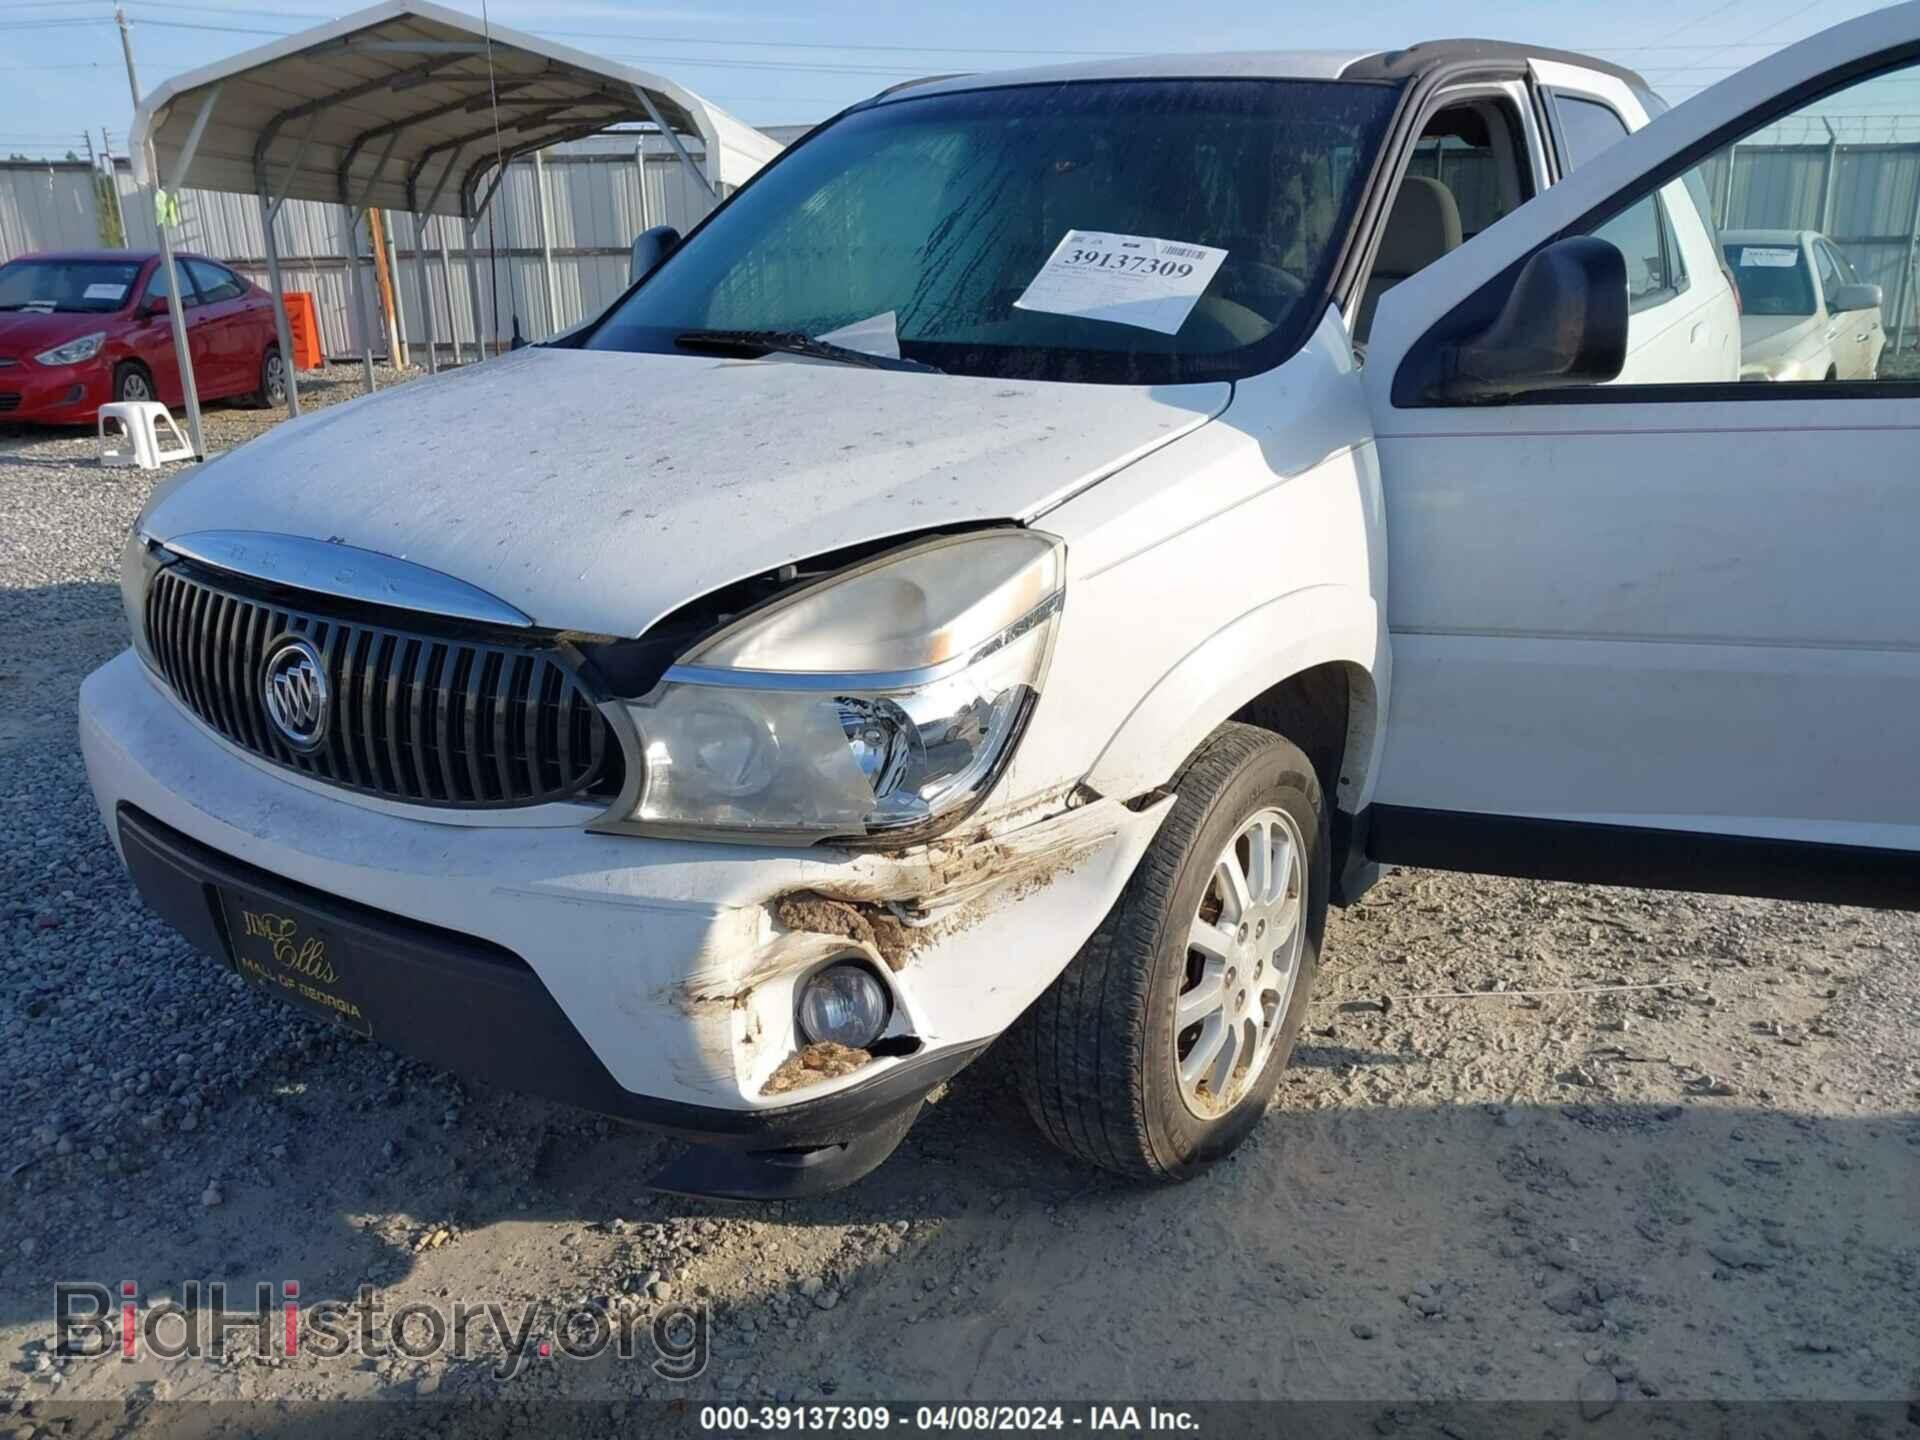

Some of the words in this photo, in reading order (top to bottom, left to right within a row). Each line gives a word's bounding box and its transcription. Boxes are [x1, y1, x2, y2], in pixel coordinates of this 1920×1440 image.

[1064, 249, 1194, 279] 39137309
[264, 913, 344, 985] Ellis
[277, 971, 297, 988] OF
[298, 982, 362, 1019] GEORGIA
